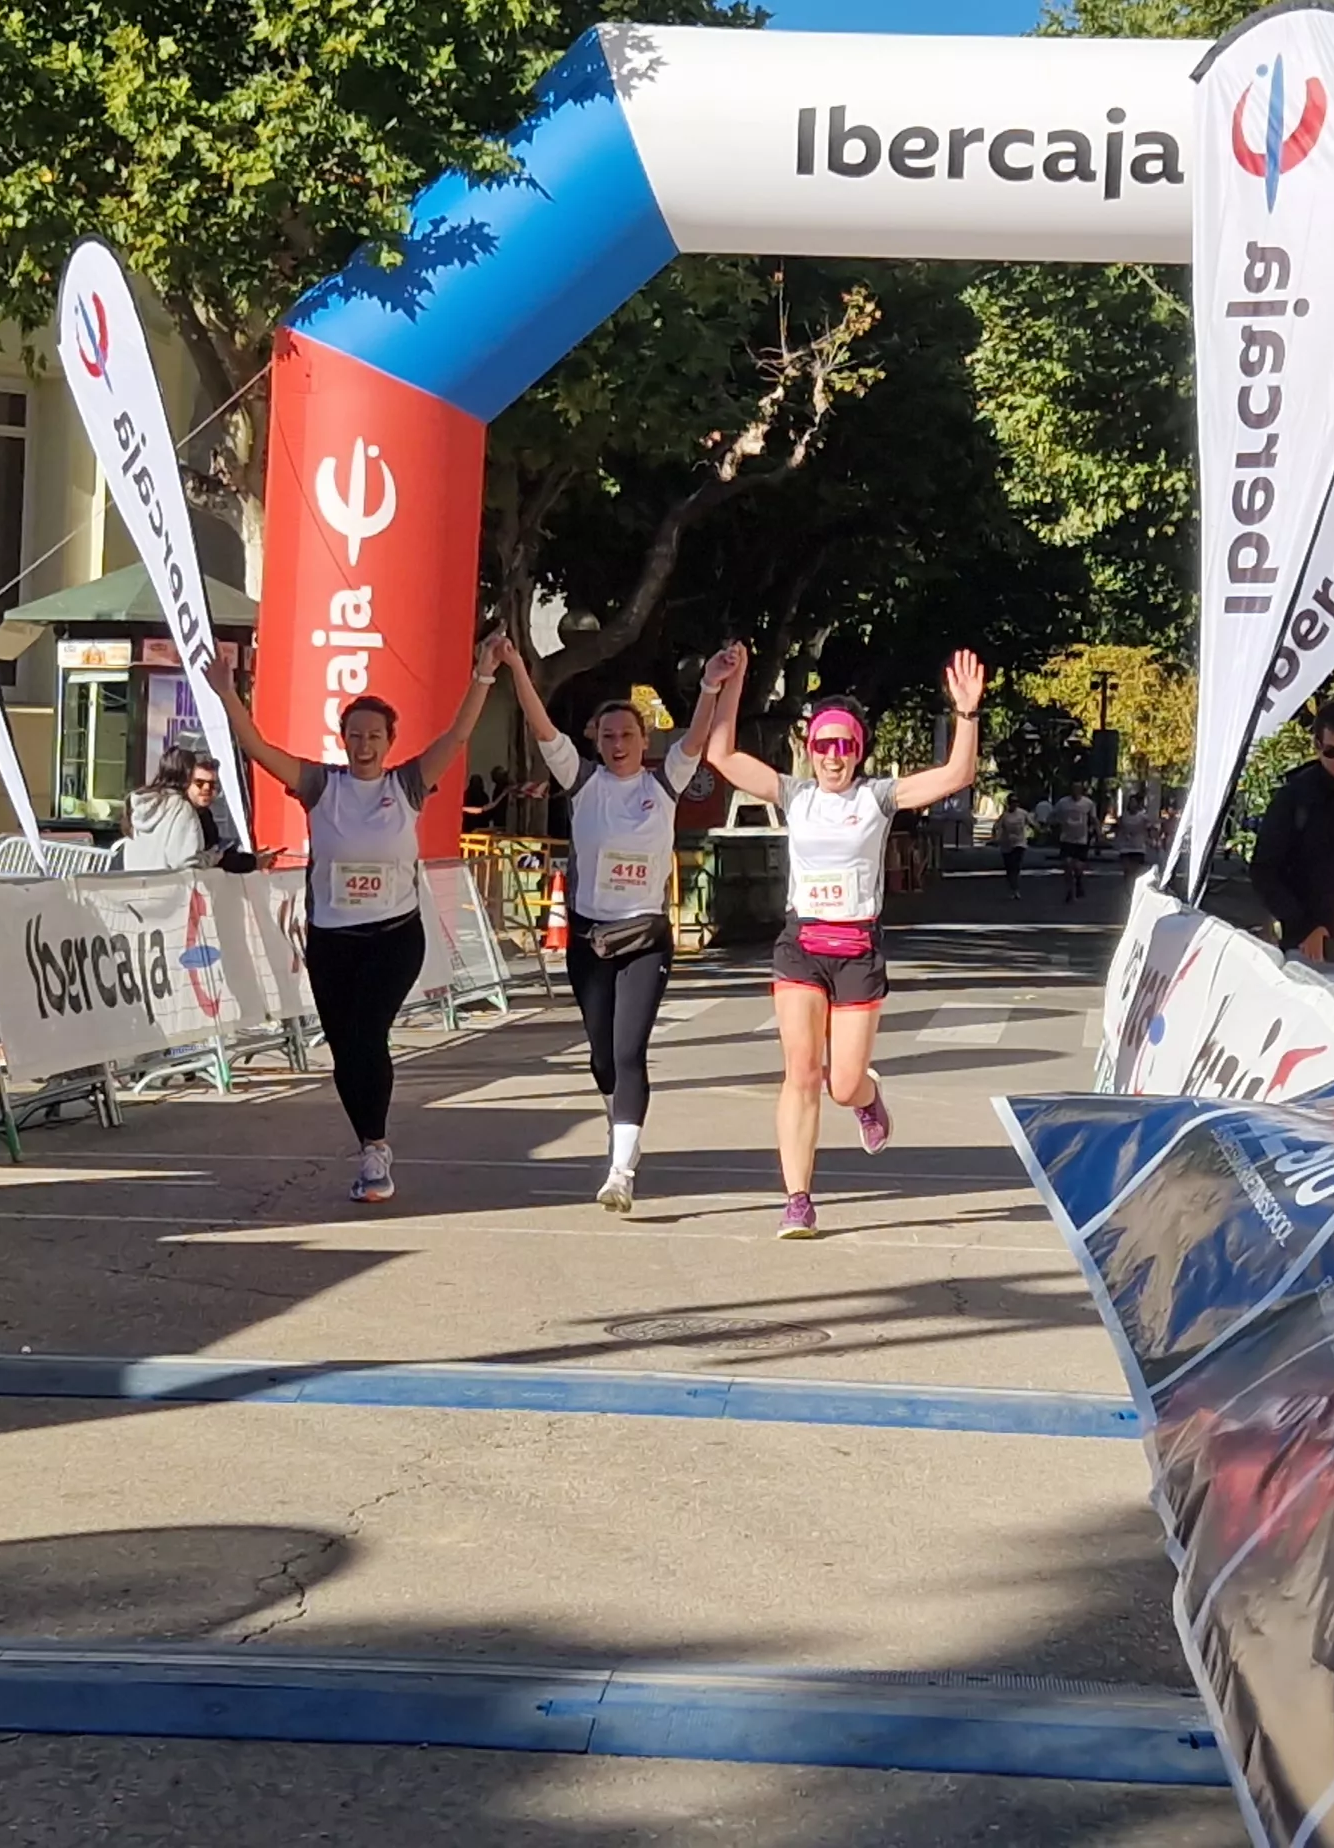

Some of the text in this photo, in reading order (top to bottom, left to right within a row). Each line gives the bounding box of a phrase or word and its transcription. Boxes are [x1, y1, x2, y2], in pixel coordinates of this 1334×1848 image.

[794, 105, 1184, 200] Ibercaja
[611, 863, 648, 878] 418
[345, 875, 382, 891] 420
[809, 885, 843, 899] 419
[26, 903, 173, 1026] Ibercaja
